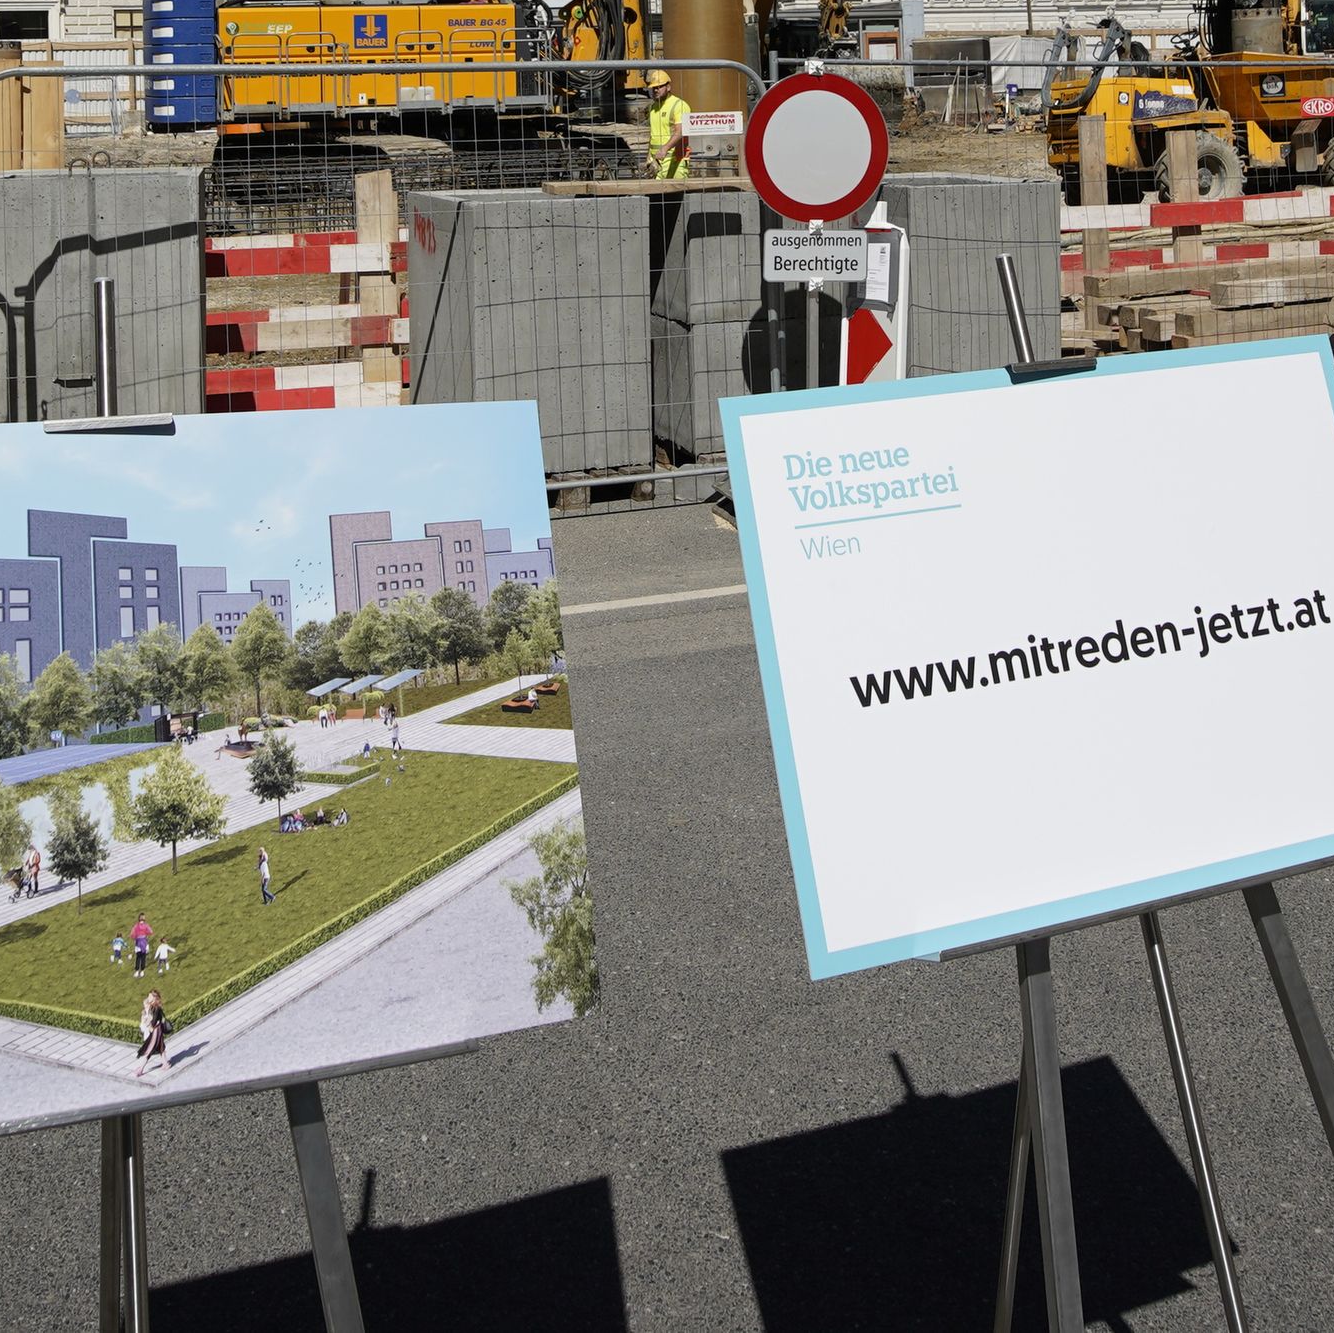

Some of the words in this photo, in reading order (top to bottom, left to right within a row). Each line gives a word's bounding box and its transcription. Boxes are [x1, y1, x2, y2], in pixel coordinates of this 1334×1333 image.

[356, 38, 386, 47] BAUER
[1304, 99, 1331, 114] EKRO
[772, 236, 862, 249] ausgenommen
[774, 255, 858, 274] Berechtigte
[783, 451, 832, 480] Die
[838, 447, 910, 474] neue
[788, 466, 959, 512] Volkspartei
[799, 536, 861, 560] Wien
[849, 590, 1331, 708] www.mitreden-jetzt.at
